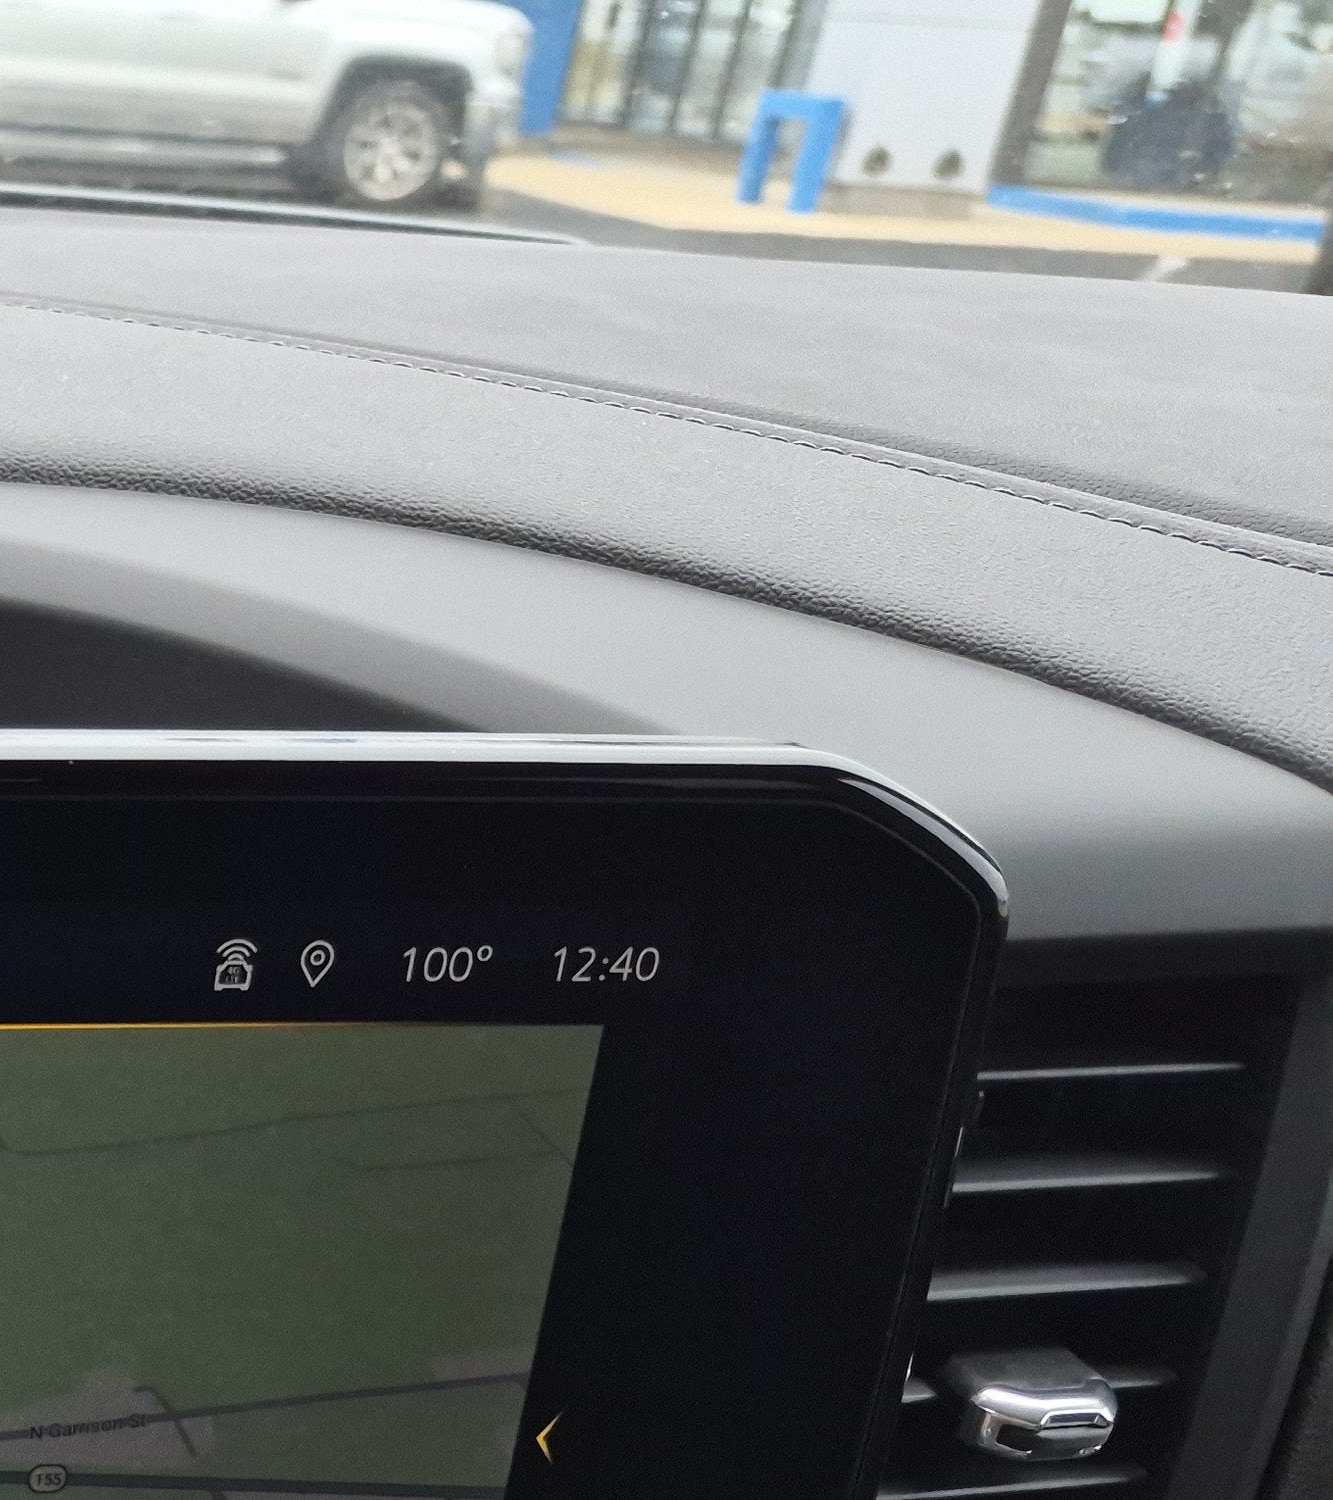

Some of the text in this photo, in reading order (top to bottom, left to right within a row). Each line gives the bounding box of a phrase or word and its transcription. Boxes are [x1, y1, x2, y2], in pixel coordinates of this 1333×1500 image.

[553, 946, 660, 982] 12:40
[30, 1413, 146, 1439] N Garrison St
[35, 1473, 63, 1486] 155
